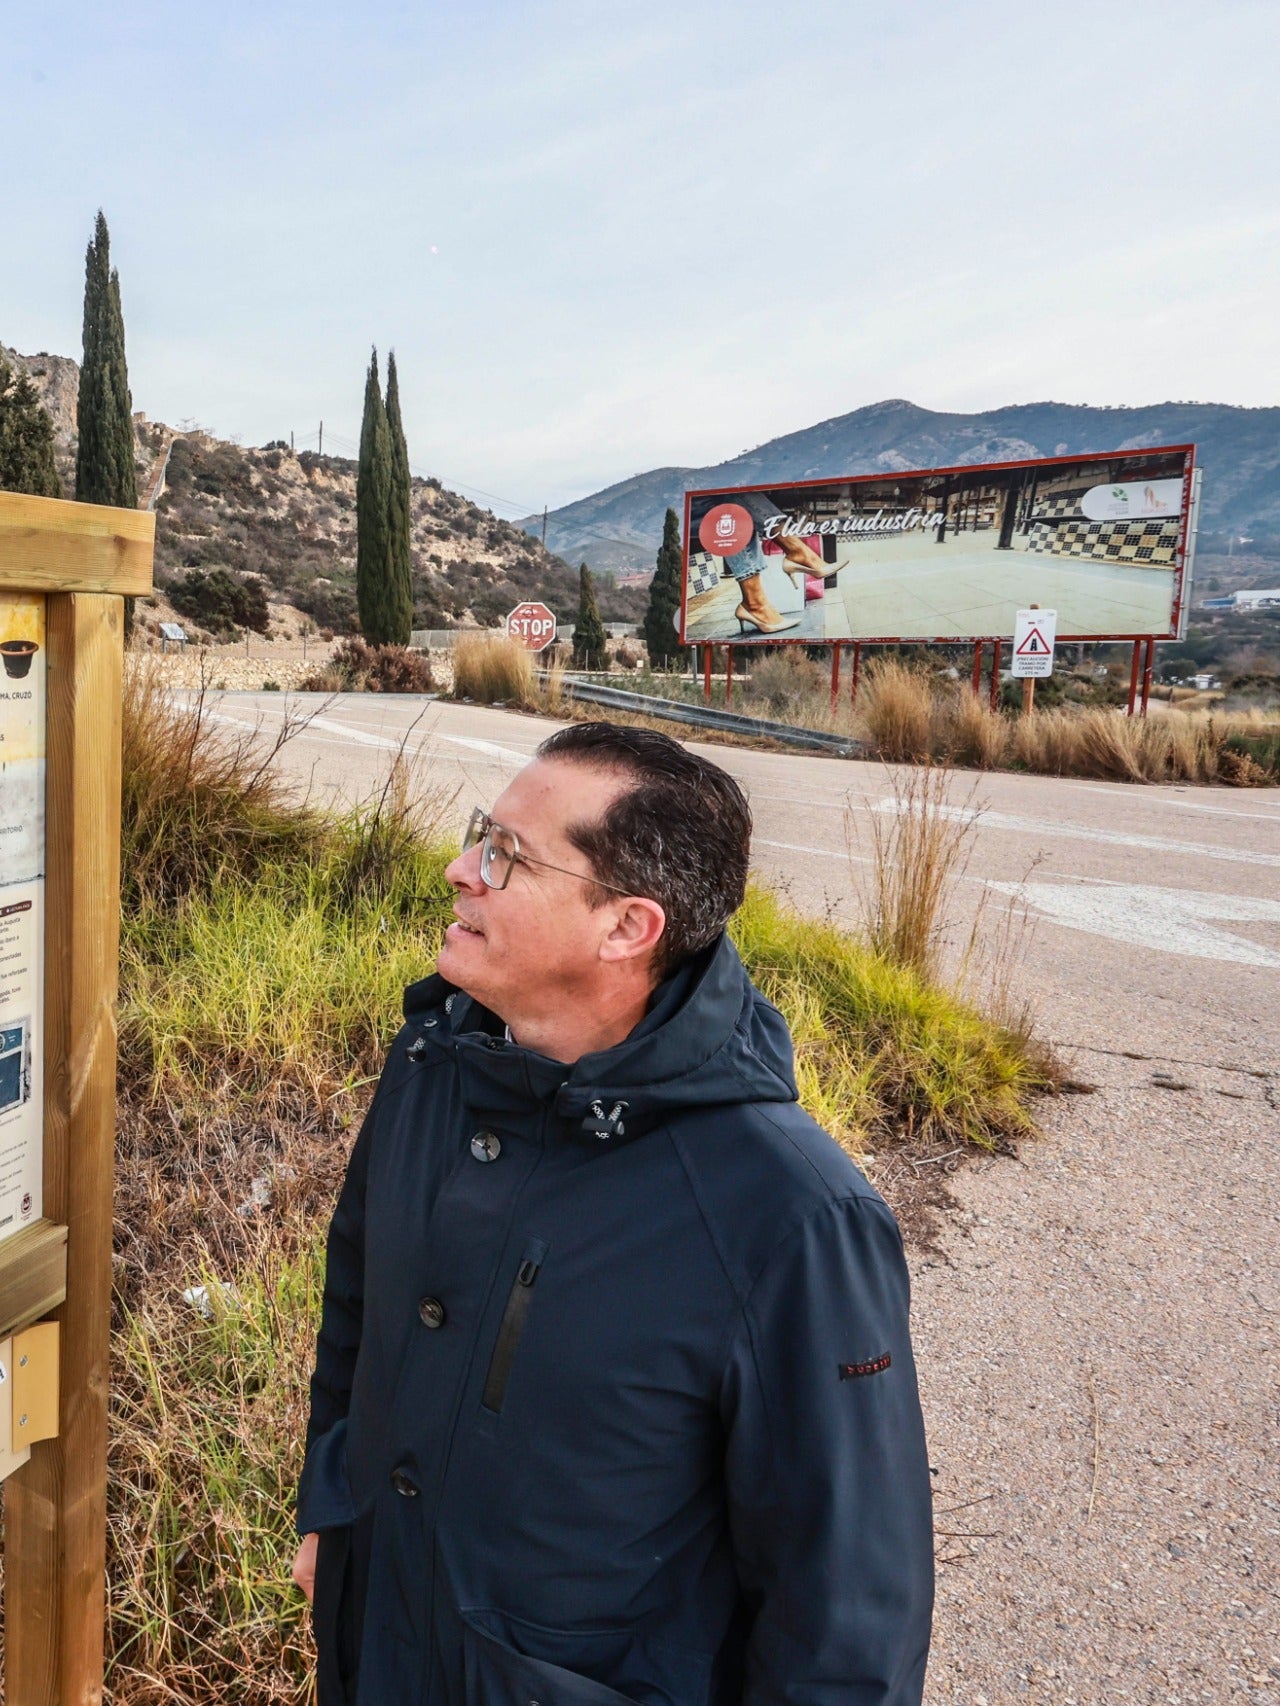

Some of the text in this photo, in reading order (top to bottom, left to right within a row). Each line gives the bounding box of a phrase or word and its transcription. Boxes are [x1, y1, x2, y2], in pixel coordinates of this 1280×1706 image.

[764, 507, 946, 540] Elda es industria
[510, 619, 553, 636] STOP
